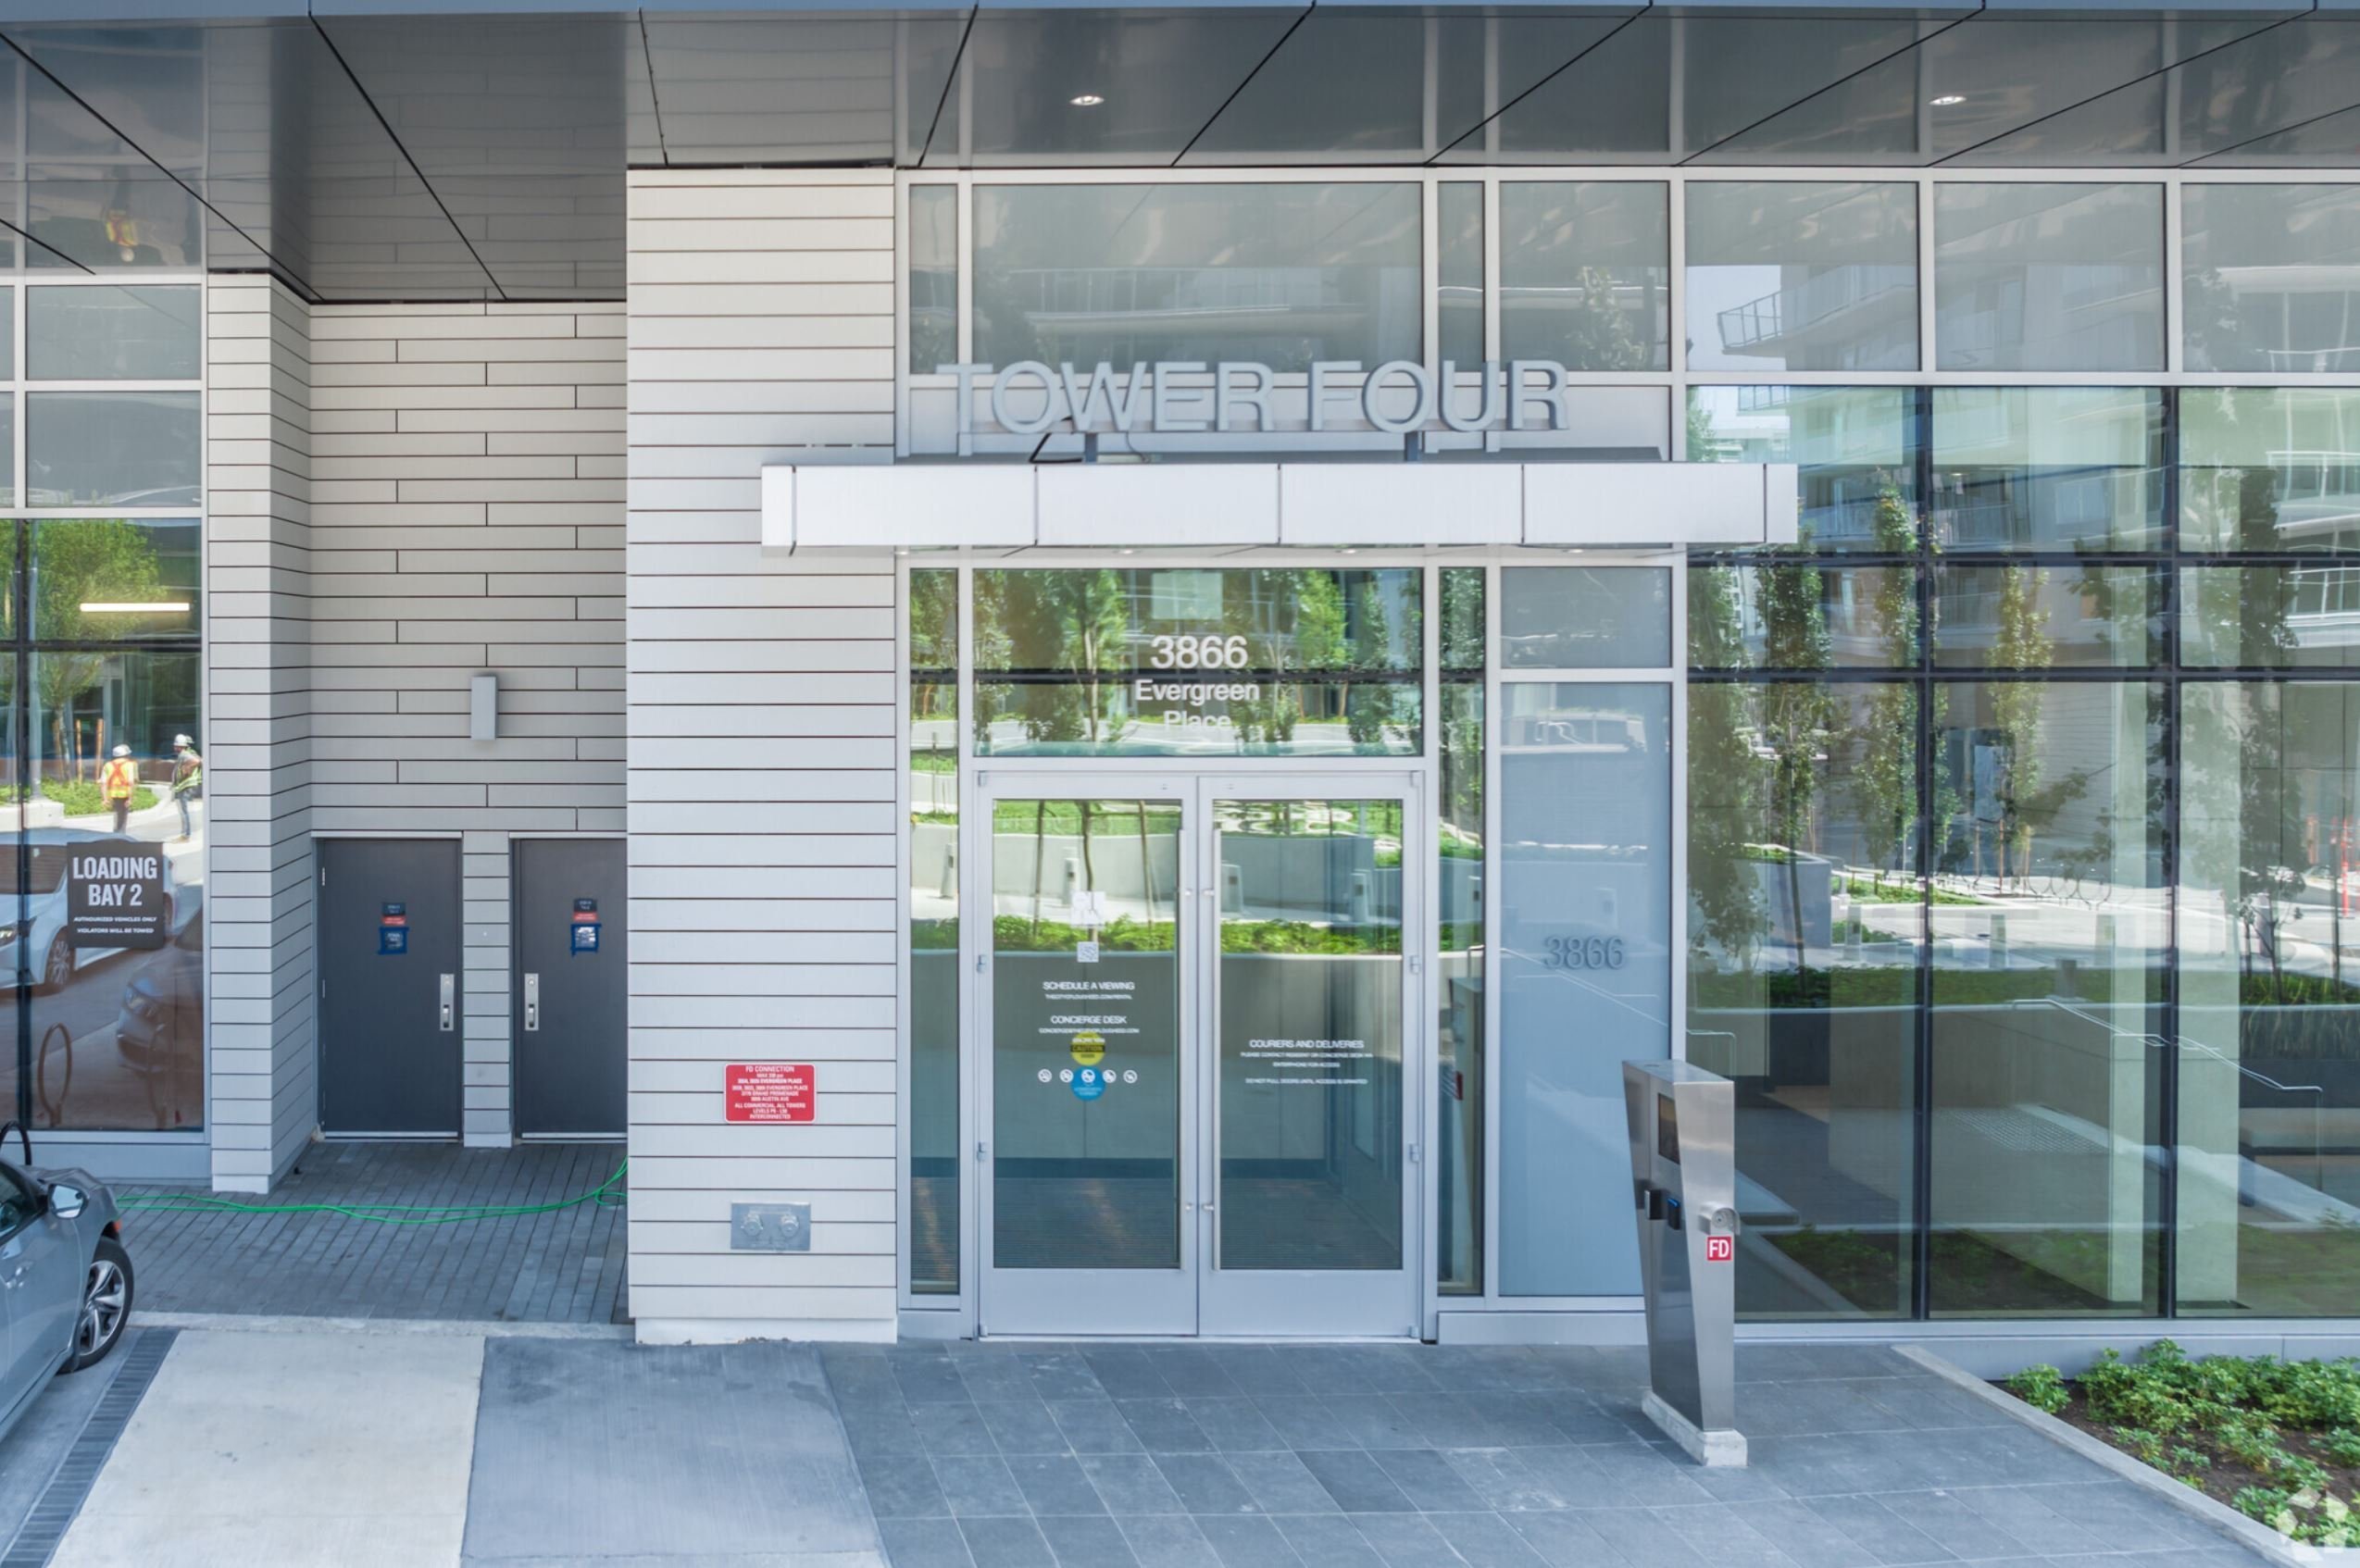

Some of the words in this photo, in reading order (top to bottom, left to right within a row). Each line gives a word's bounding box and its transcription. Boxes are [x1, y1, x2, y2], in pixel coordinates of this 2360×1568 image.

[937, 359, 1274, 433] TOWER
[1310, 359, 1569, 433] FOUR
[1150, 635, 1248, 668] 3866
[1135, 678, 1260, 706] Evergreen
[1163, 710, 1232, 730] Place
[73, 857, 157, 879] LOADING
[88, 884, 126, 906] BAY
[130, 884, 143, 906] 2
[1542, 935, 1626, 970] 3866
[1043, 981, 1090, 990] SCHEDULE
[1091, 981, 1098, 990] A
[1098, 981, 1135, 990] VIEWING
[1050, 1014, 1102, 1024] CONCIERGE
[1103, 1014, 1128, 1024] DESK
[1249, 1039, 1294, 1048] COURIERS
[1294, 1039, 1315, 1048] AND
[1316, 1039, 1364, 1048] DELIVERIES
[1708, 1238, 1729, 1259] FD
